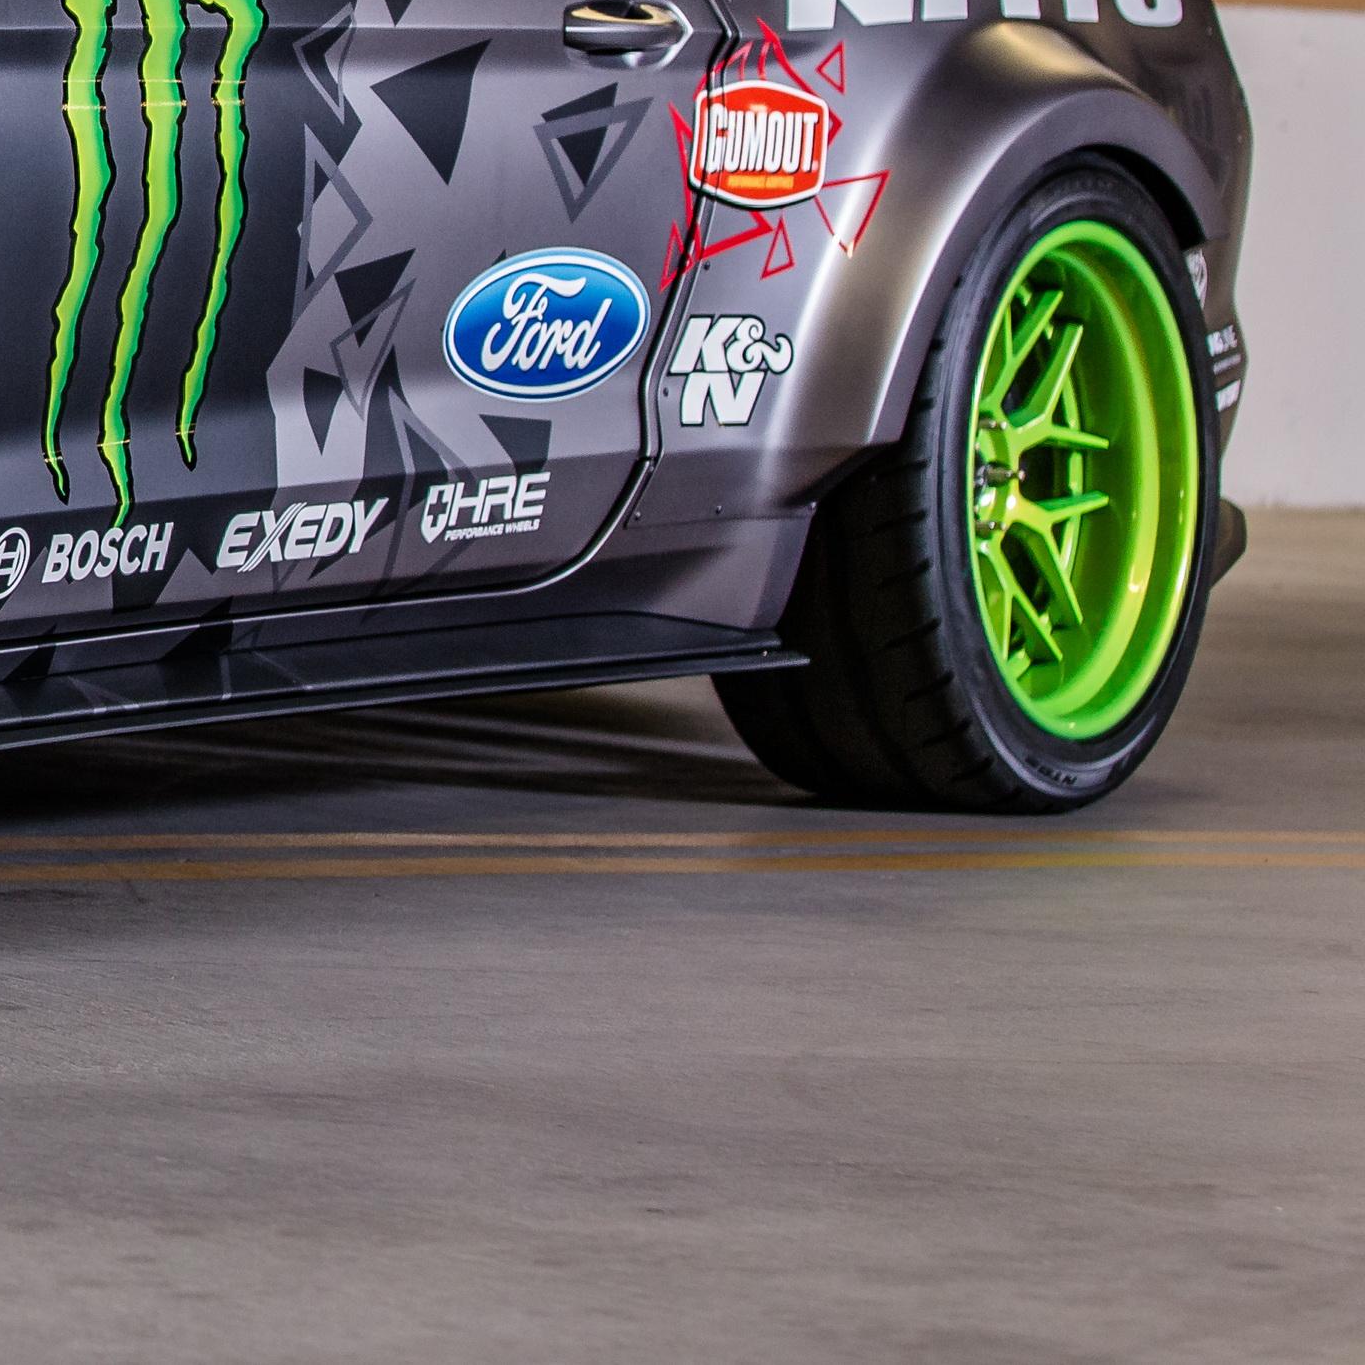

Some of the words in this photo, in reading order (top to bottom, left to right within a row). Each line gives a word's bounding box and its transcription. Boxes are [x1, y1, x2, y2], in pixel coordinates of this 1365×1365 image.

[700, 102, 819, 174] GUMOUT
[479, 273, 613, 375] Ford
[443, 522, 505, 542] PERFORMANCE
[504, 518, 541, 535] WHEELS
[448, 471, 551, 526] HRE
[41, 522, 175, 583] BOSCH
[215, 497, 389, 574] EXEDY
